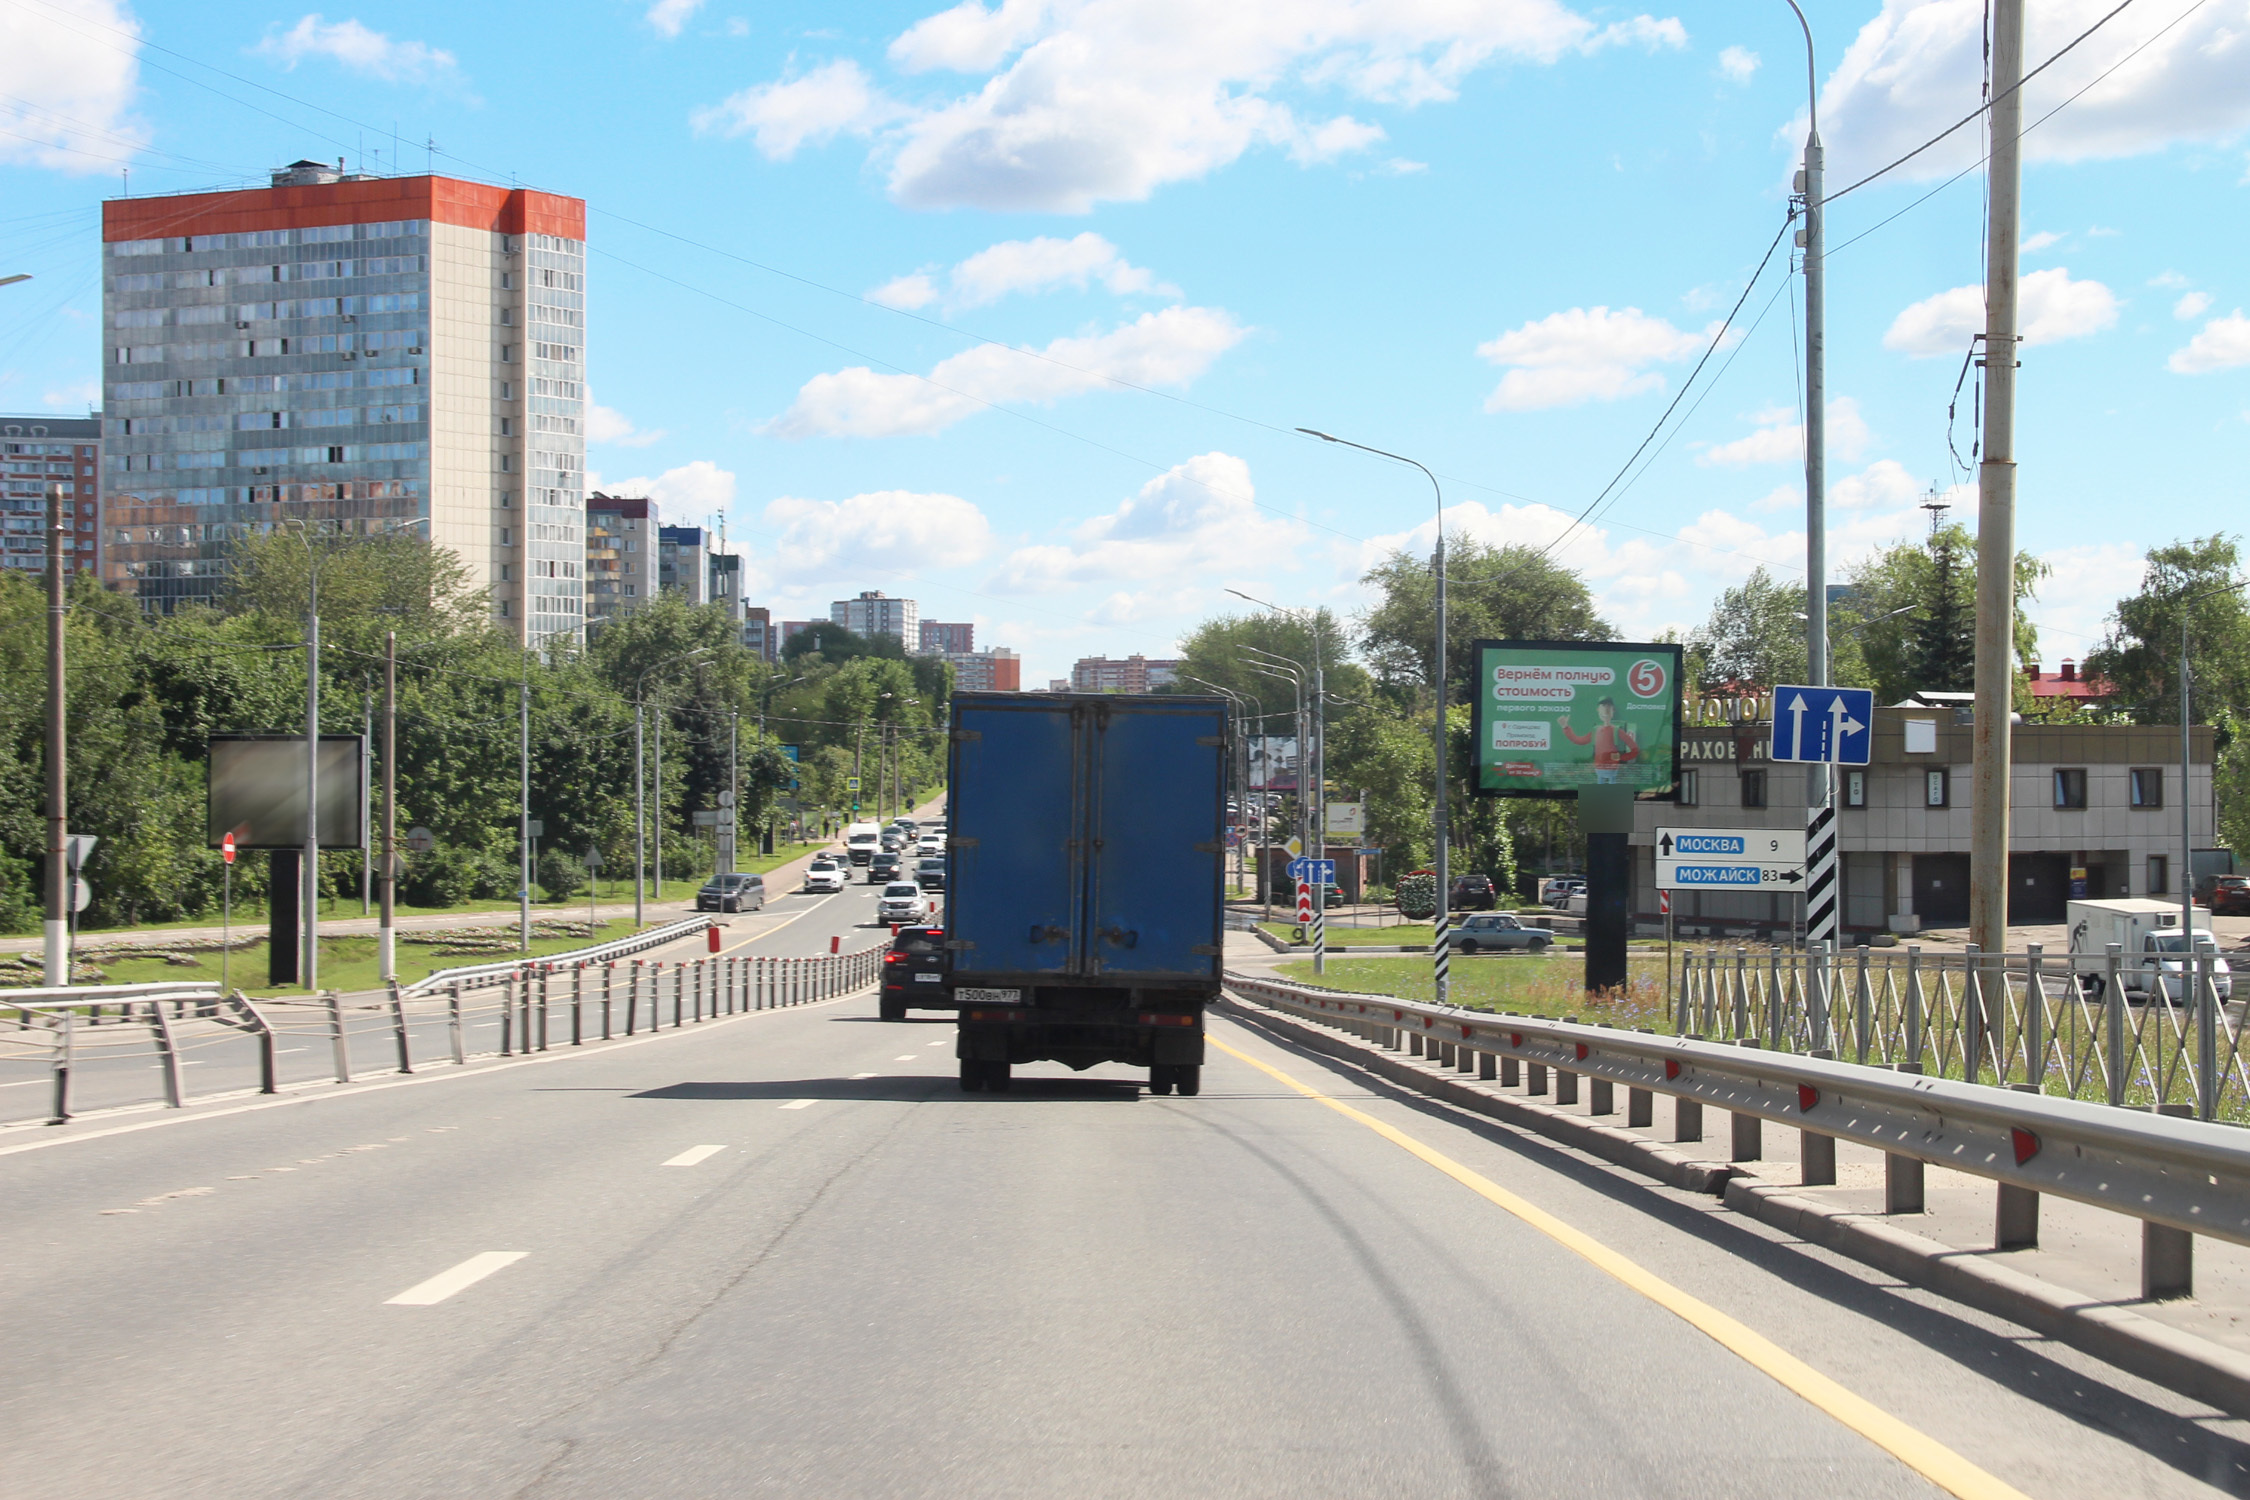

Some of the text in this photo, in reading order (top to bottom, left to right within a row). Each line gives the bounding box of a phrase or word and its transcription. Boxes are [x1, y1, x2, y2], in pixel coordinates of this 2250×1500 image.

[1497, 668, 1611, 684] Вернём полную
[1497, 687, 1572, 697] стоимость
[1496, 704, 1536, 713] первого
[1626, 702, 1667, 711] Доставка
[1495, 738, 1547, 748] ПОПРОБУЙ
[1679, 838, 1779, 852] МОСКВА 9
[1679, 867, 1778, 882] МОЖАЙСК 83
